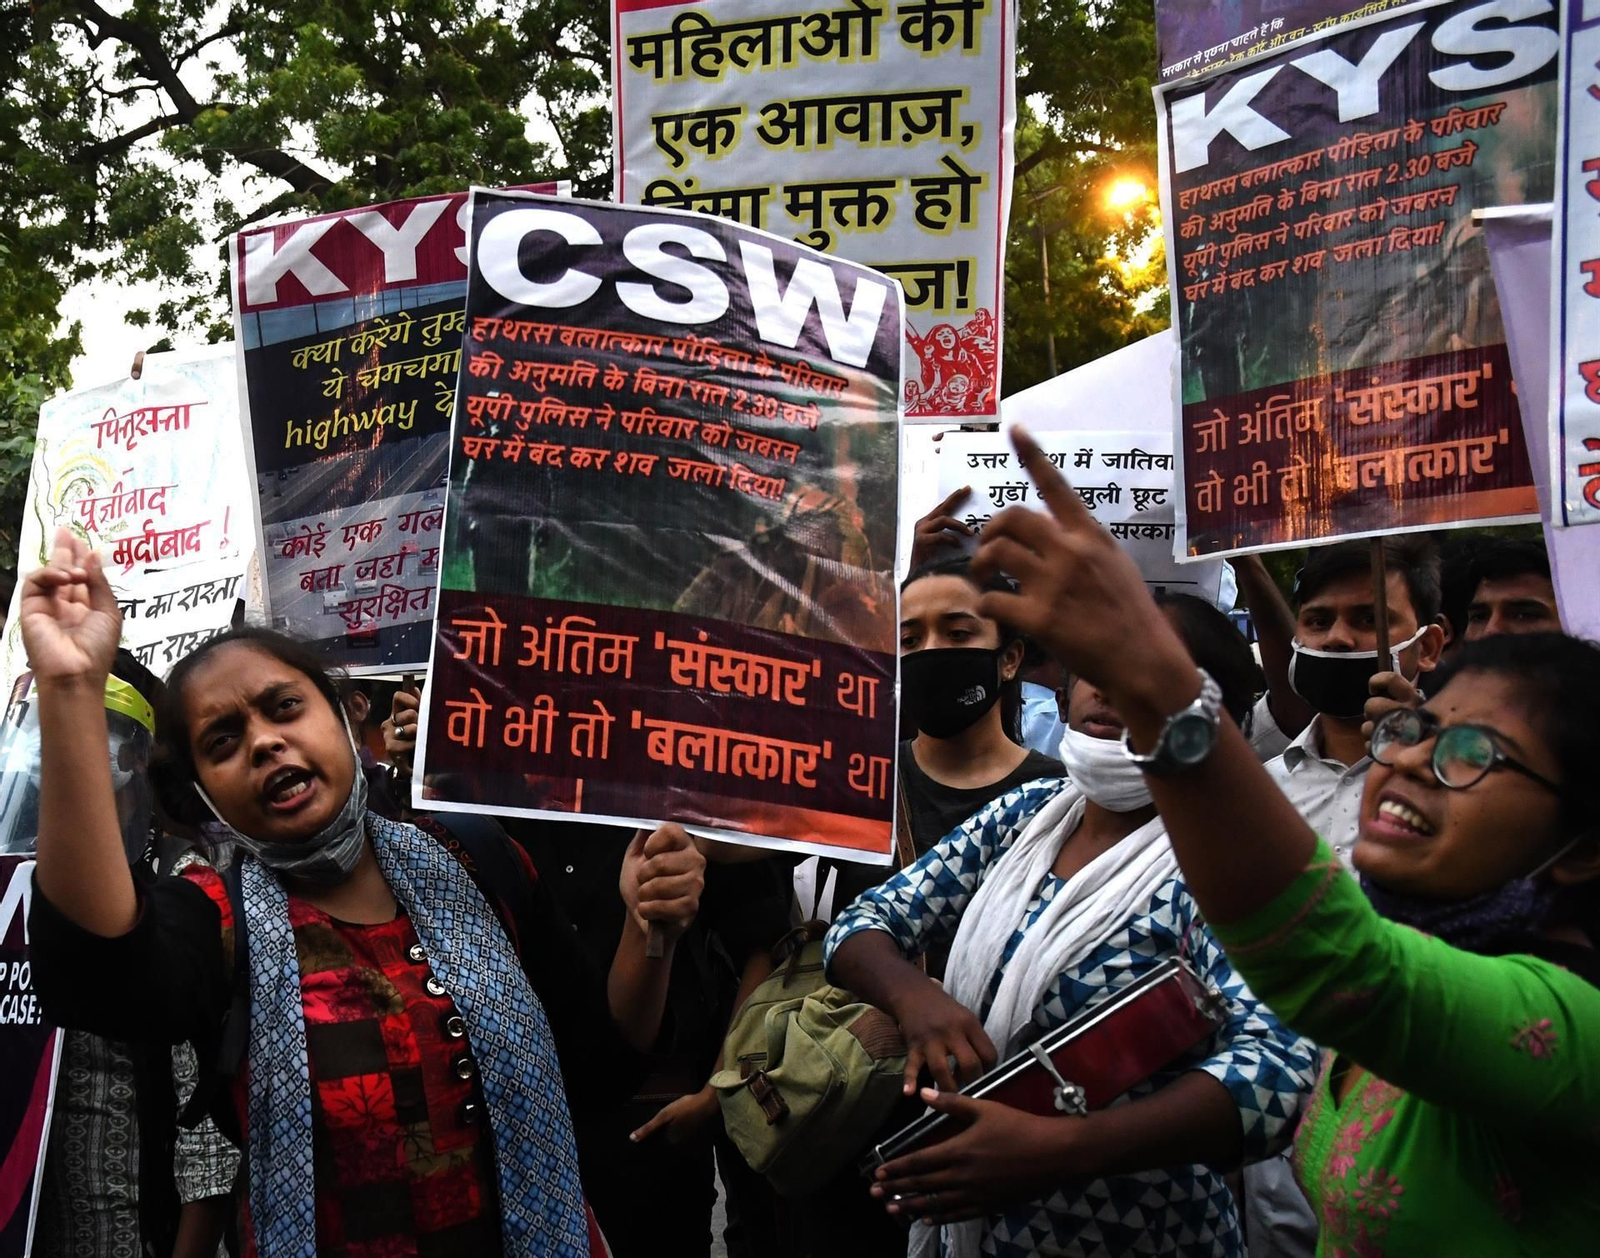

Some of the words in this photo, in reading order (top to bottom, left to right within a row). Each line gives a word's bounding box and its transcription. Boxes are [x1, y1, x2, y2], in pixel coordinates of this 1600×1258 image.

[1161, 58, 1193, 78] सरकार
[1193, 49, 1203, 66] से
[1203, 41, 1230, 65] पूछना
[1230, 25, 1258, 47] चाहते
[1171, 0, 1559, 174] KYS
[652, 106, 741, 168] एक
[757, 89, 974, 148] आवाज़,
[1178, 172, 1238, 210] हाथरस
[1239, 148, 1325, 187] बलात्कार
[1327, 127, 1400, 163] पीड़िता
[1402, 119, 1424, 143] के
[1429, 102, 1507, 138] परिवार
[641, 178, 769, 232] िंसा
[784, 180, 896, 252] मुक्त
[911, 155, 981, 229] हो
[1180, 213, 1206, 238] की
[1208, 193, 1274, 234] अनुमति
[1277, 187, 1297, 210] के
[1300, 176, 1343, 208] बिना
[1344, 167, 1382, 194] रात
[1384, 154, 1432, 186] 2.30
[1435, 140, 1478, 173] बजे
[247, 198, 468, 306] KY
[1182, 242, 1217, 280] यूपी
[1219, 231, 1271, 267] पुलिस
[1273, 224, 1289, 248] ने
[1294, 207, 1354, 241] परिवार
[1358, 196, 1387, 227] को
[1389, 184, 1460, 217] जबरन
[1183, 277, 1212, 303] घर
[1210, 268, 1228, 297] में
[1228, 263, 1257, 292] बंद
[1259, 258, 1289, 284] कर
[1291, 247, 1325, 275] शव
[1331, 232, 1386, 264] जला
[1388, 220, 1445, 252] दिया!
[477, 208, 888, 369] CSW
[291, 337, 346, 369] क्या
[349, 311, 417, 354] करेंगे
[471, 316, 557, 347] हाथरस
[559, 324, 669, 357] बलात्कार
[672, 331, 753, 374] पीड़िता
[754, 349, 775, 378] के
[779, 358, 848, 400] परिवार
[321, 368, 348, 399] ये
[468, 350, 500, 380] की
[508, 358, 597, 393] अनुमति
[604, 362, 626, 391] के
[633, 366, 686, 399] बिना
[688, 382, 728, 407] रात
[729, 386, 779, 421] 2.30
[781, 394, 823, 431] बजे
[1192, 407, 1230, 454] जो
[1238, 393, 1326, 446] अंतिम
[1335, 363, 1493, 427] 'संस्कार'
[285, 400, 418, 450] highway
[467, 389, 512, 428] यूपी
[516, 396, 590, 431] पुलिस
[595, 401, 616, 429] ने
[620, 404, 704, 441] परिवार
[701, 413, 733, 447] को
[734, 428, 801, 466] जबरन
[967, 452, 1009, 469] उत्तर
[1074, 449, 1093, 469] में
[462, 436, 501, 461] घर
[502, 433, 527, 463] में
[528, 436, 566, 470] बंद
[569, 445, 609, 471] कर
[615, 449, 660, 476] शव
[667, 456, 724, 488] जला
[729, 463, 785, 501] दिया!
[989, 481, 1028, 507] गुंडों
[1074, 482, 1122, 510] खुली
[1130, 487, 1168, 511] छूट
[1194, 468, 1226, 514] वो
[1233, 461, 1271, 506] भी
[1276, 454, 1312, 502] तो
[110, 518, 211, 575] मुर्दाबाद
[279, 522, 331, 559] कोई
[341, 518, 387, 551] एक
[299, 565, 346, 593] बता
[355, 546, 416, 580] जहां
[145, 591, 178, 619] का
[177, 573, 244, 612] रास्ता
[338, 583, 437, 630] सुरक्षित
[452, 606, 507, 666] जो
[518, 614, 640, 679] अंतिम
[654, 629, 821, 705] 'संस्कार'
[836, 671, 880, 718] था
[445, 687, 492, 748] वो
[503, 693, 559, 755] भी
[567, 699, 615, 760] तो
[630, 710, 832, 788] 'बलात्कार'
[848, 752, 892, 800] था
[9, 961, 34, 990] PO
